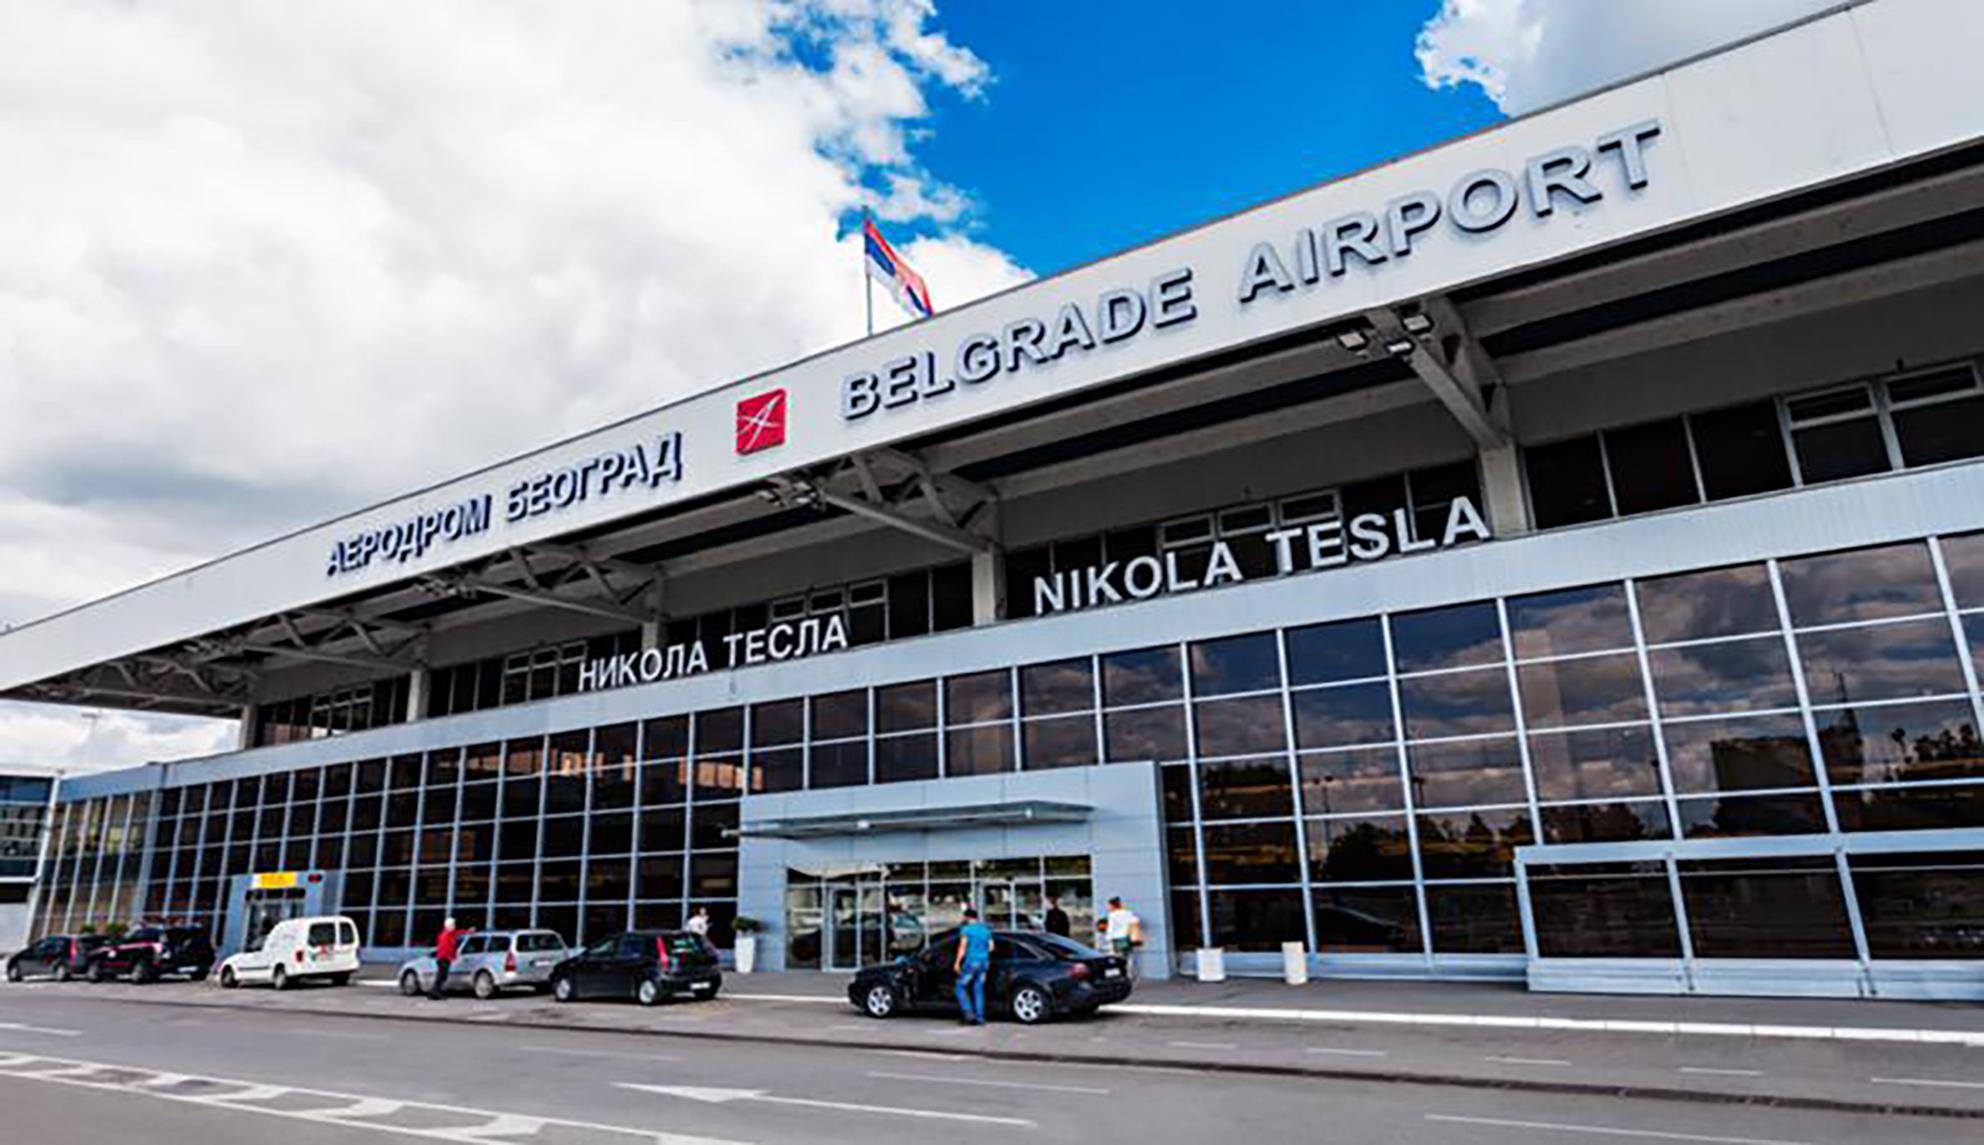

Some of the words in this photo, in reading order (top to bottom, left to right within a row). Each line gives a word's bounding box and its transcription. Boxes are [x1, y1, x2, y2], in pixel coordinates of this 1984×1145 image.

[842, 266, 1198, 421] BELGRADE
[1238, 119, 1662, 304] AIRPORT
[327, 493, 492, 576] АЕРОДРОМ
[506, 431, 684, 522] БЕОГРАД
[1033, 541, 1245, 616] NIKOLA
[1265, 495, 1493, 575] TESLA
[578, 641, 709, 692] НИКОЛА
[722, 614, 849, 668] ТЕСЛА
